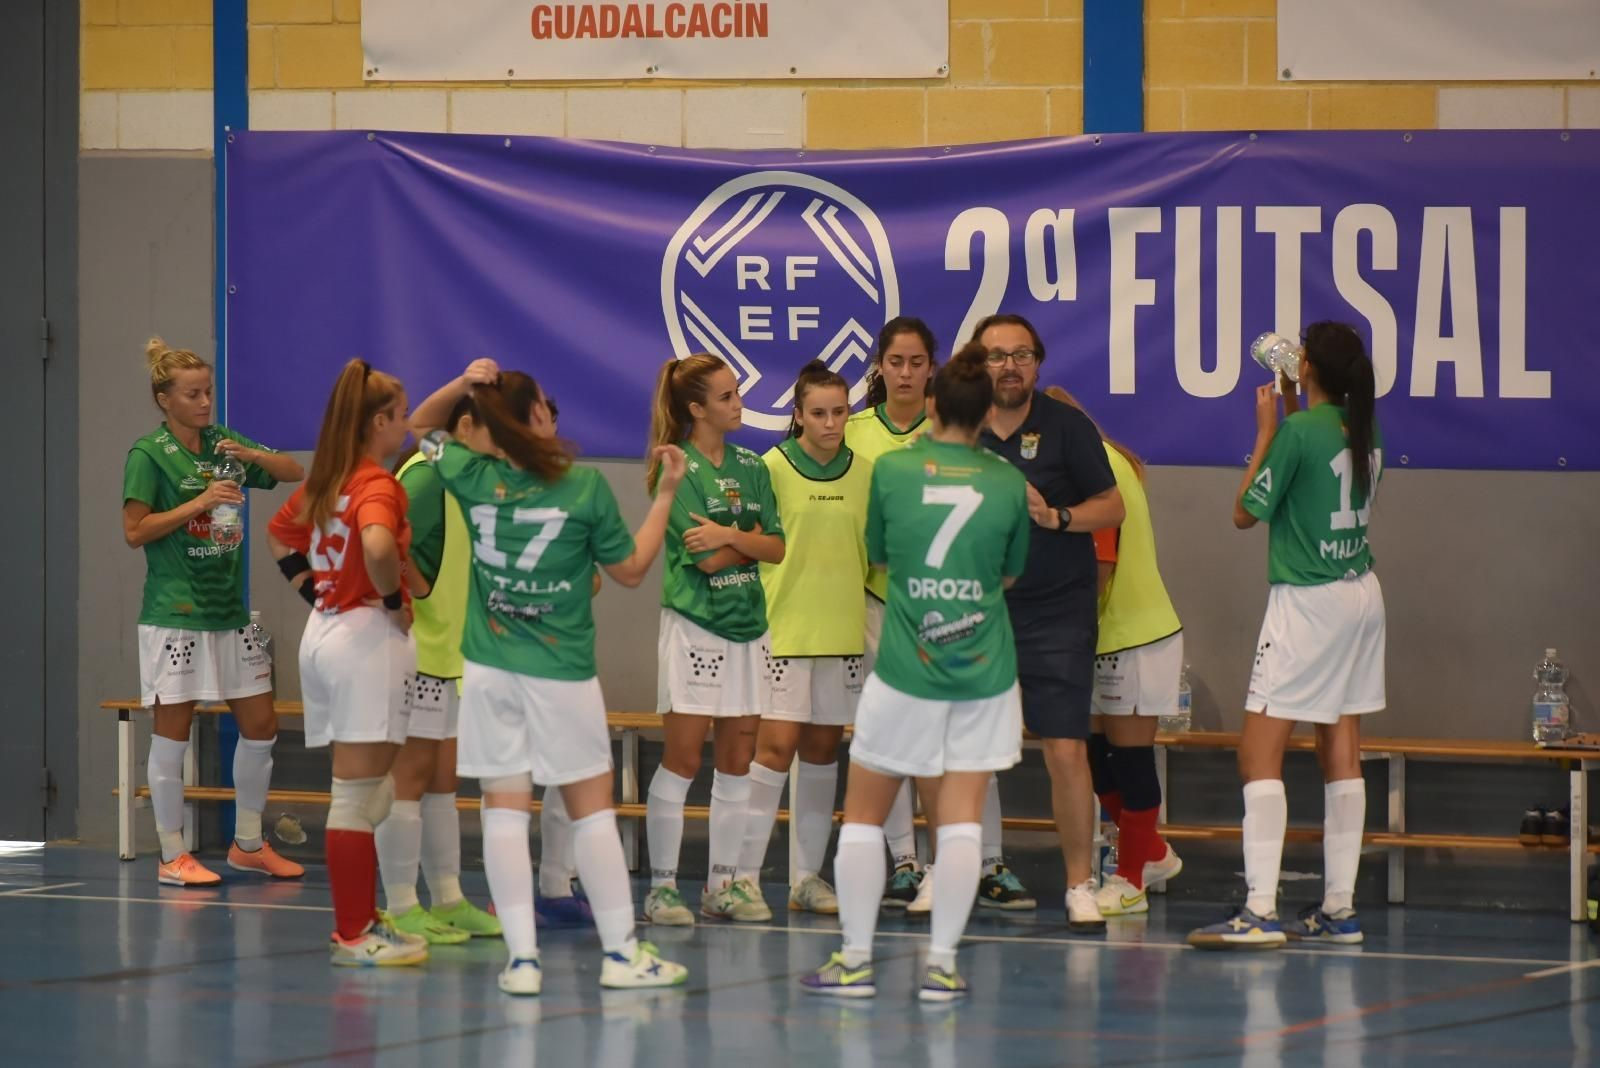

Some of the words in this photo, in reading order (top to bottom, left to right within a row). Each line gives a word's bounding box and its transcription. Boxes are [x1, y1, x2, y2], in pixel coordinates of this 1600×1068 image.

[1107, 203, 1552, 399] FUTSAL
[469, 503, 569, 573] 17
[922, 484, 984, 570] 7
[907, 576, 984, 602] DROZD
